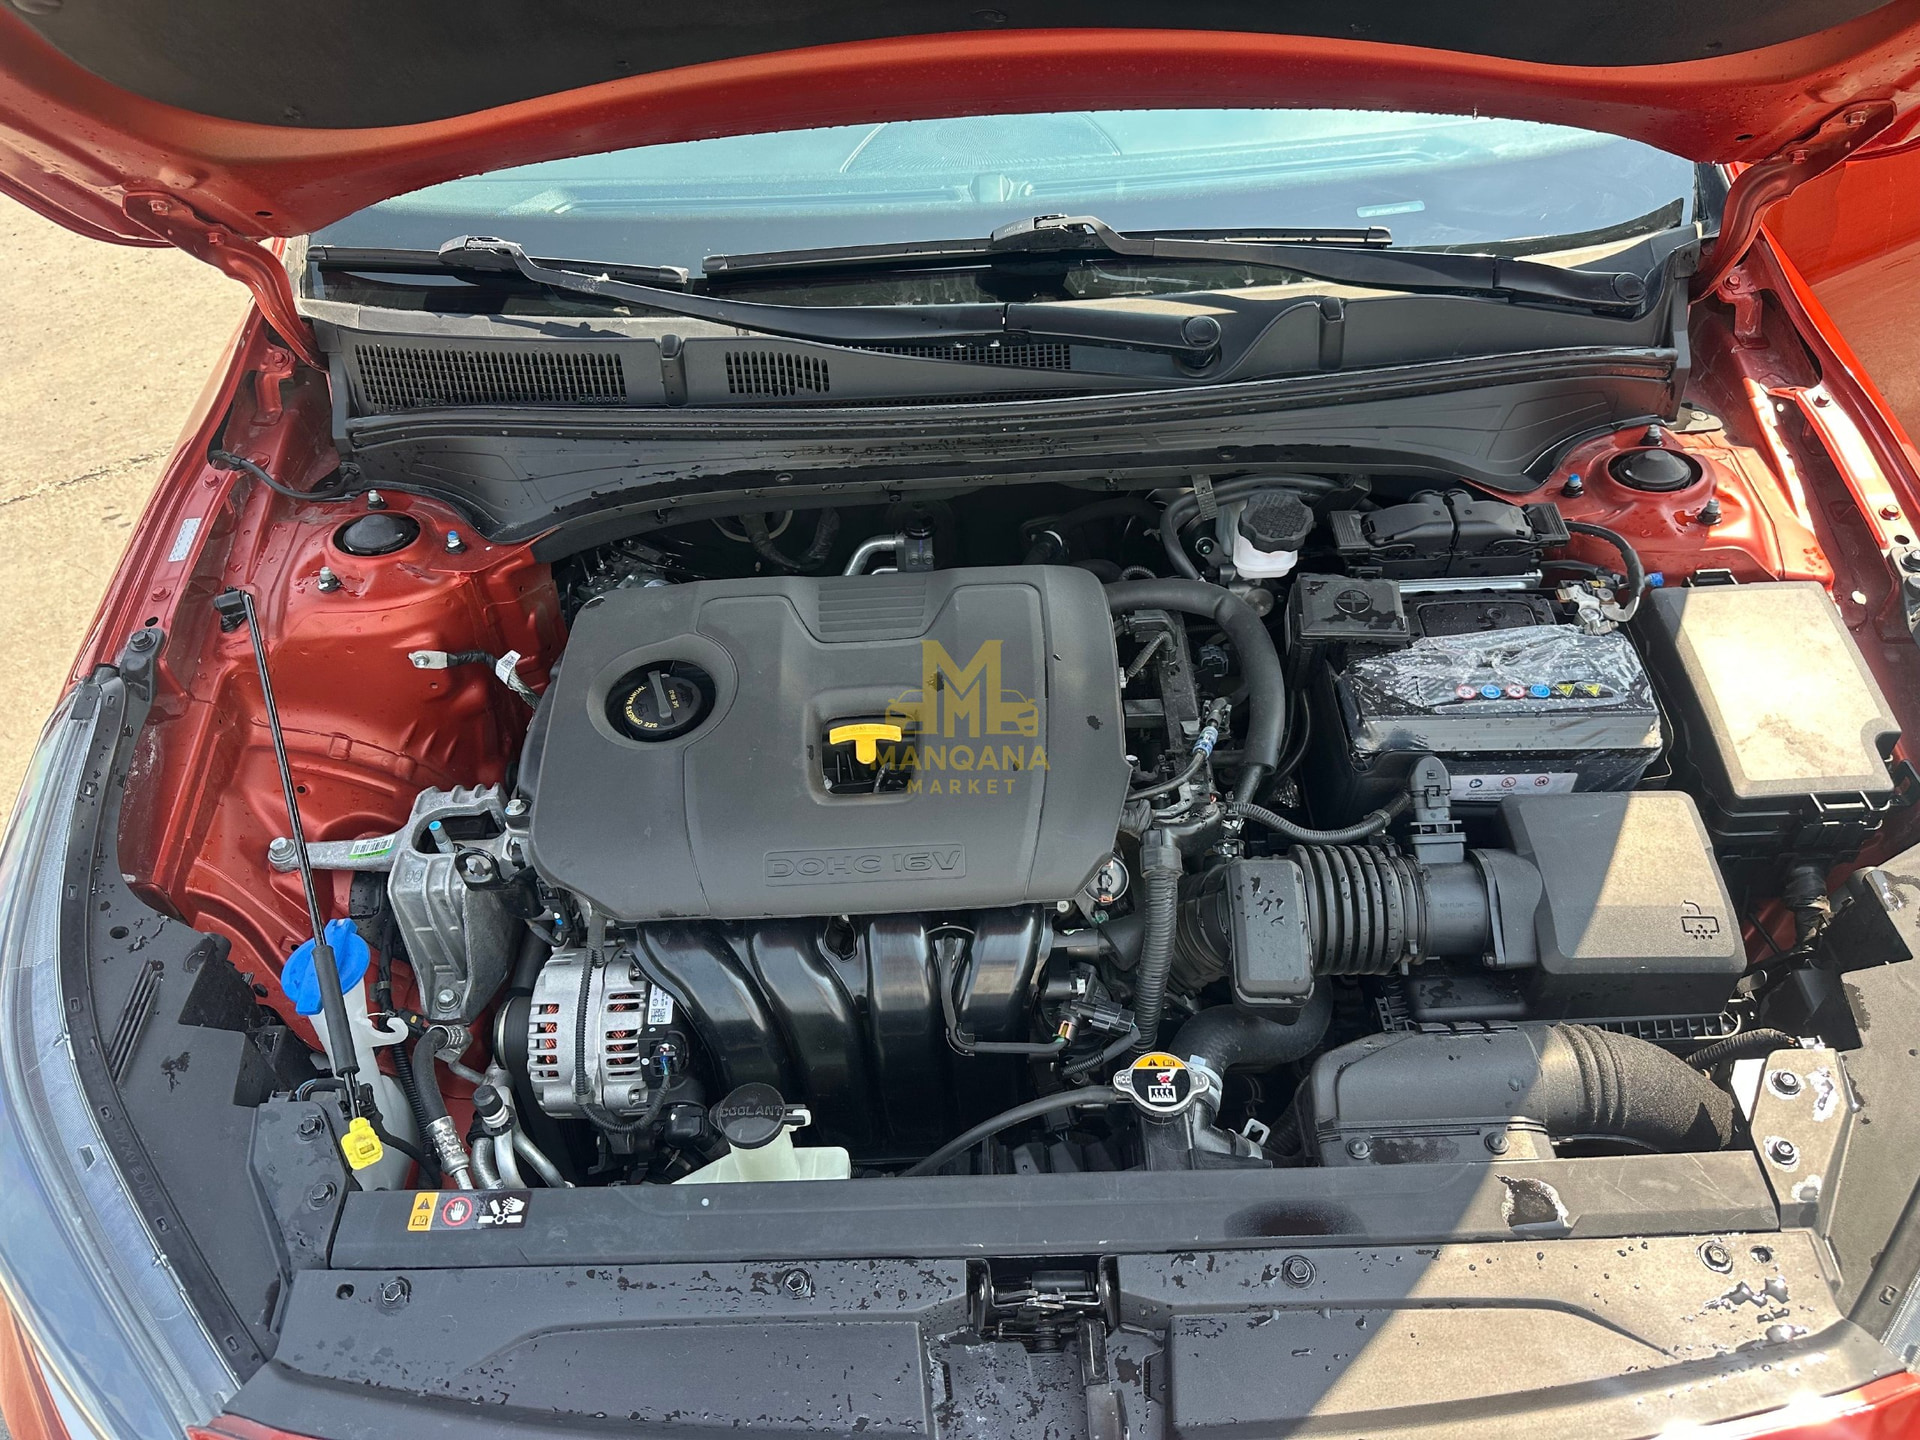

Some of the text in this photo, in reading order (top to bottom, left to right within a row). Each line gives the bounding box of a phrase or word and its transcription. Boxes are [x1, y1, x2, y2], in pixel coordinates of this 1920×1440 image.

[626, 685, 647, 705] MANUAL
[767, 850, 961, 878] DOHC 16V
[1115, 1075, 1131, 1084] HCC
[1194, 1076, 1206, 1085] 1.1
[720, 1105, 783, 1118] COOLANT
